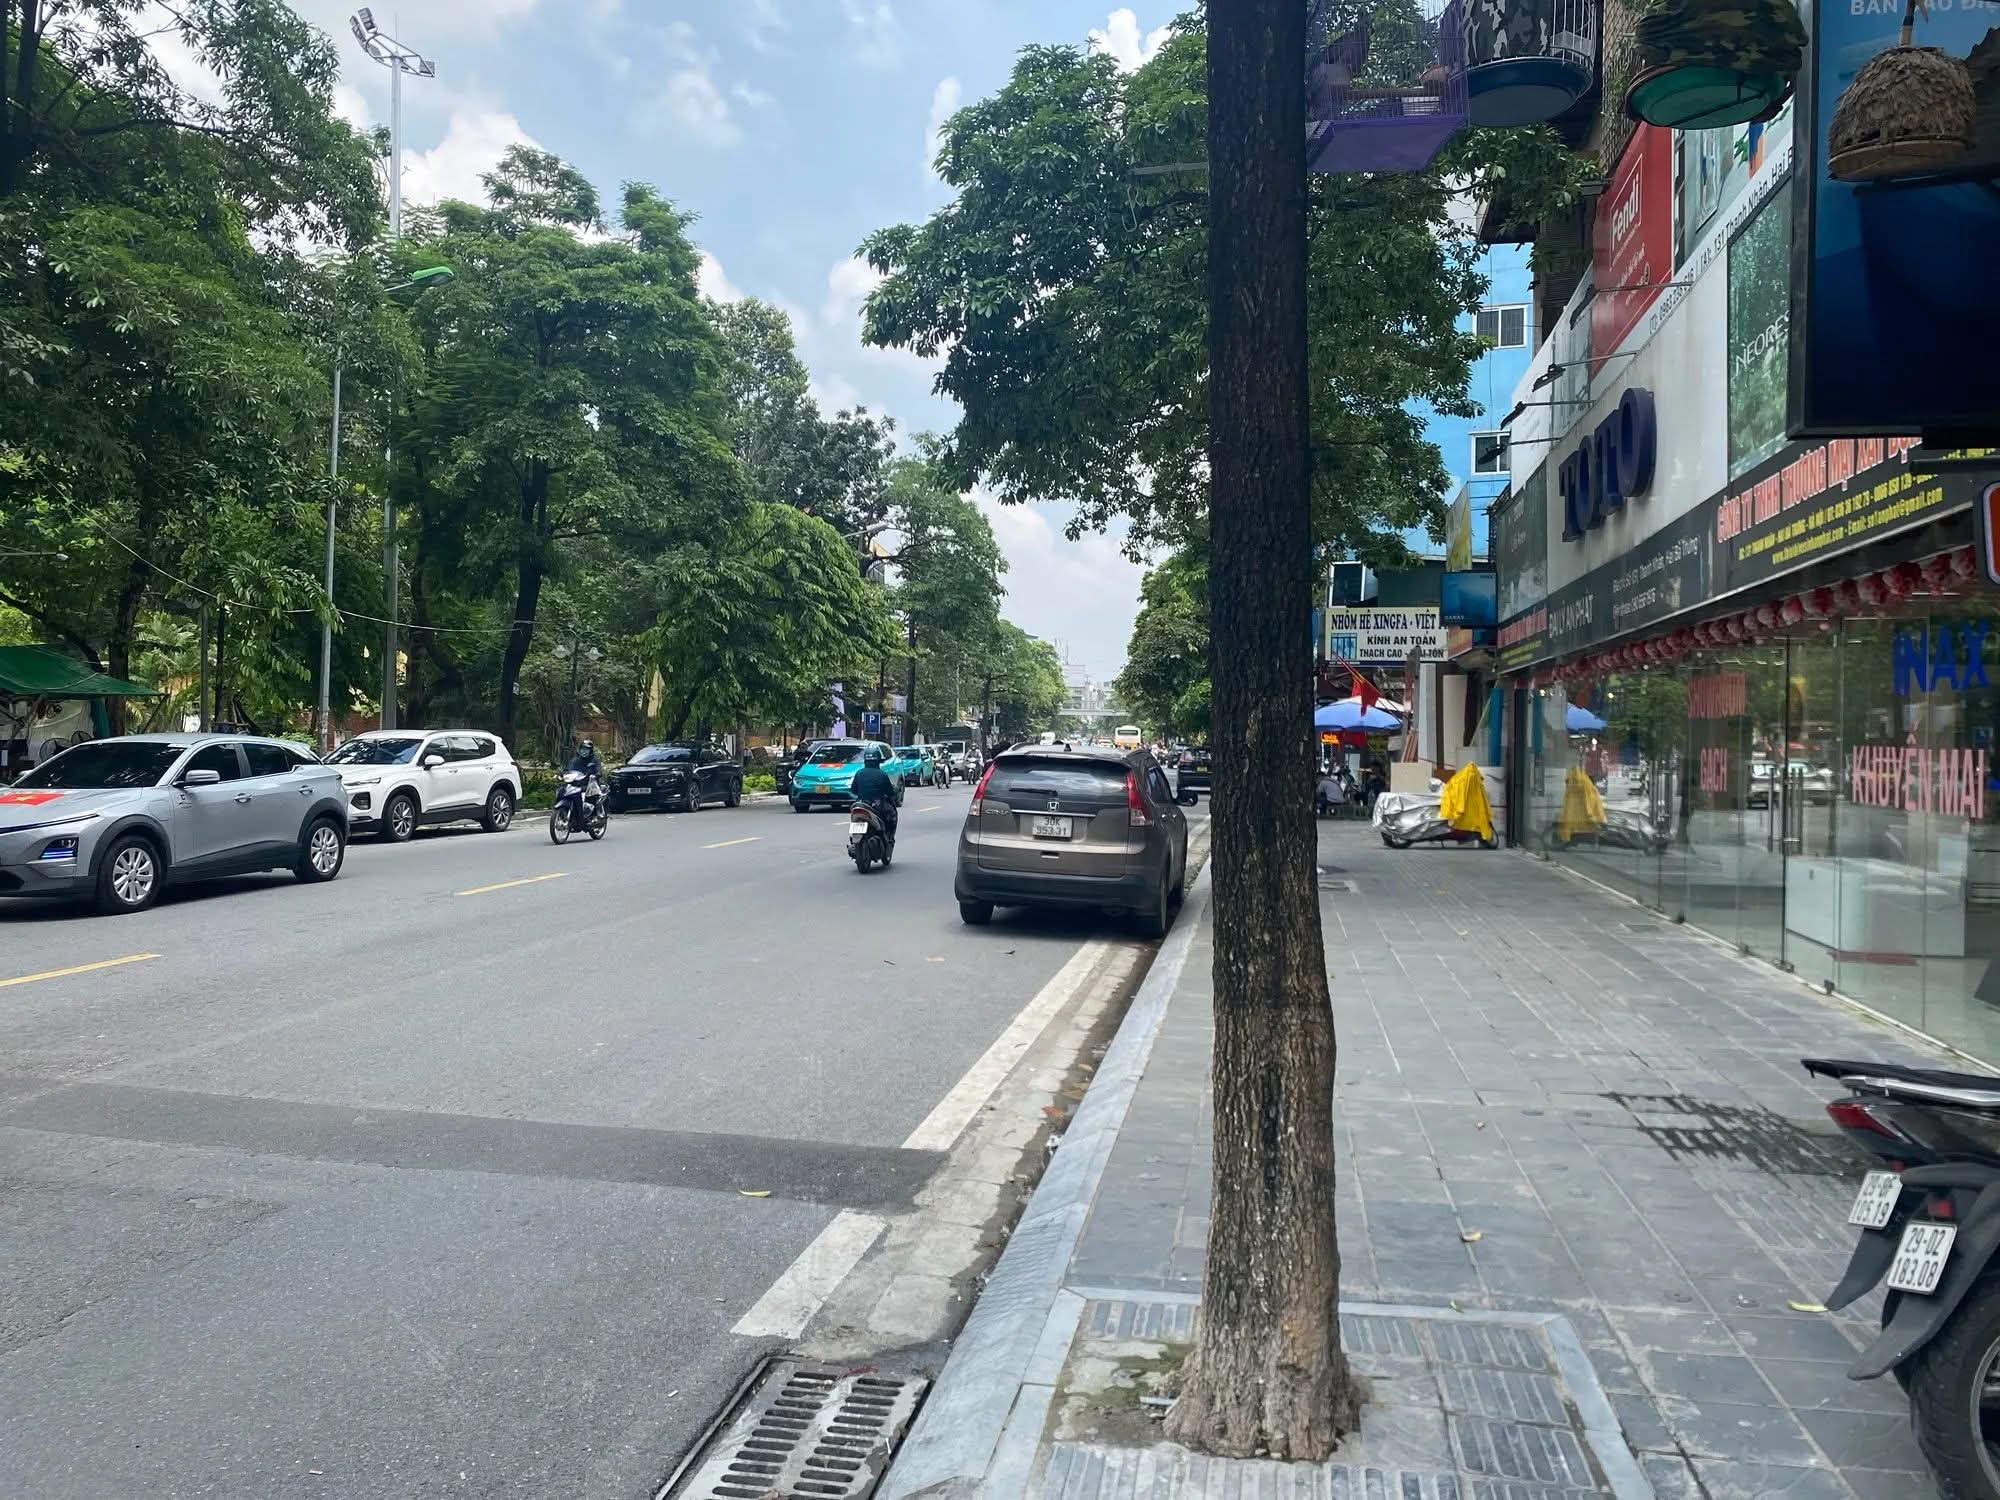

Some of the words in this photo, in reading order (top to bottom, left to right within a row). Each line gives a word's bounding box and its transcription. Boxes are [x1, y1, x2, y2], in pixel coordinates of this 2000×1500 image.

[1612, 173, 1640, 252] Fendi
[1725, 205, 1747, 239] Thanh
[1771, 160, 1785, 186] Hai
[1558, 387, 1658, 543] TOTO
[1717, 495, 1741, 544] CÔNG
[1740, 487, 1754, 532] TY
[1753, 471, 1781, 525] TNHH
[1780, 445, 1827, 512] THƯƠNG
[1827, 438, 1856, 492] MẠI
[1331, 609, 1357, 630] NHÔM
[1373, 613, 1408, 630] XINGFA
[1415, 608, 1437, 634] VIỆT
[1367, 633, 1391, 645] KÍNH
[1393, 636, 1408, 645] AN
[1387, 648, 1403, 658] CAO
[1892, 619, 1989, 696] INAX
[869, 715, 876, 723] P
[1852, 719, 1933, 815] KHUYẾN
[1905, 1226, 1946, 1257] 29-02
[1892, 1257, 1939, 1289] 183.08
